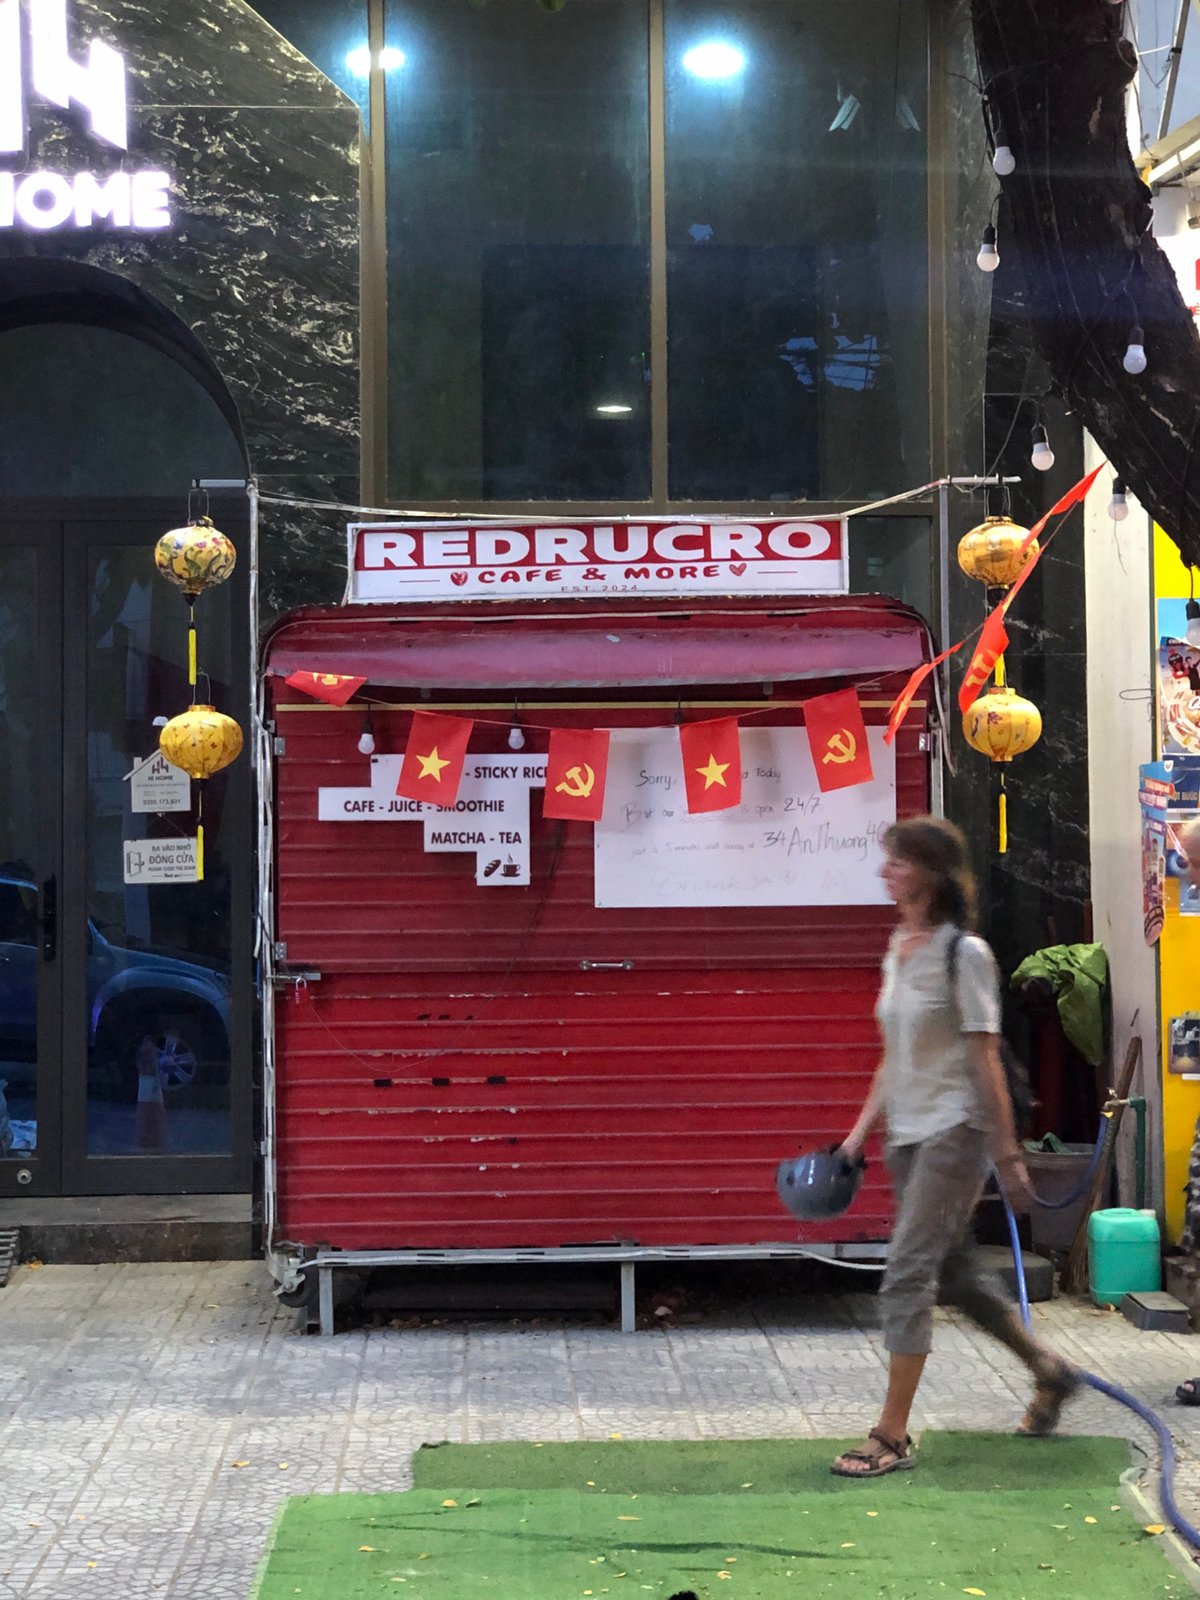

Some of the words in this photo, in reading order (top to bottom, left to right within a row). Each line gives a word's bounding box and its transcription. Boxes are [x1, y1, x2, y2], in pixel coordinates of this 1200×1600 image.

[363, 522, 832, 568] REDRUCRO
[478, 568, 563, 584] CAFE
[582, 567, 607, 580] &
[623, 564, 721, 580] MORE
[601, 584, 639, 592] 2024
[474, 766, 518, 779] STICKY
[755, 767, 781, 784] Today
[343, 800, 375, 813] CAFE
[387, 800, 423, 813] JUICE
[784, 792, 821, 816] 24/7
[431, 832, 486, 844] MATCHA
[499, 832, 522, 844] TEA
[763, 829, 787, 849] 34
